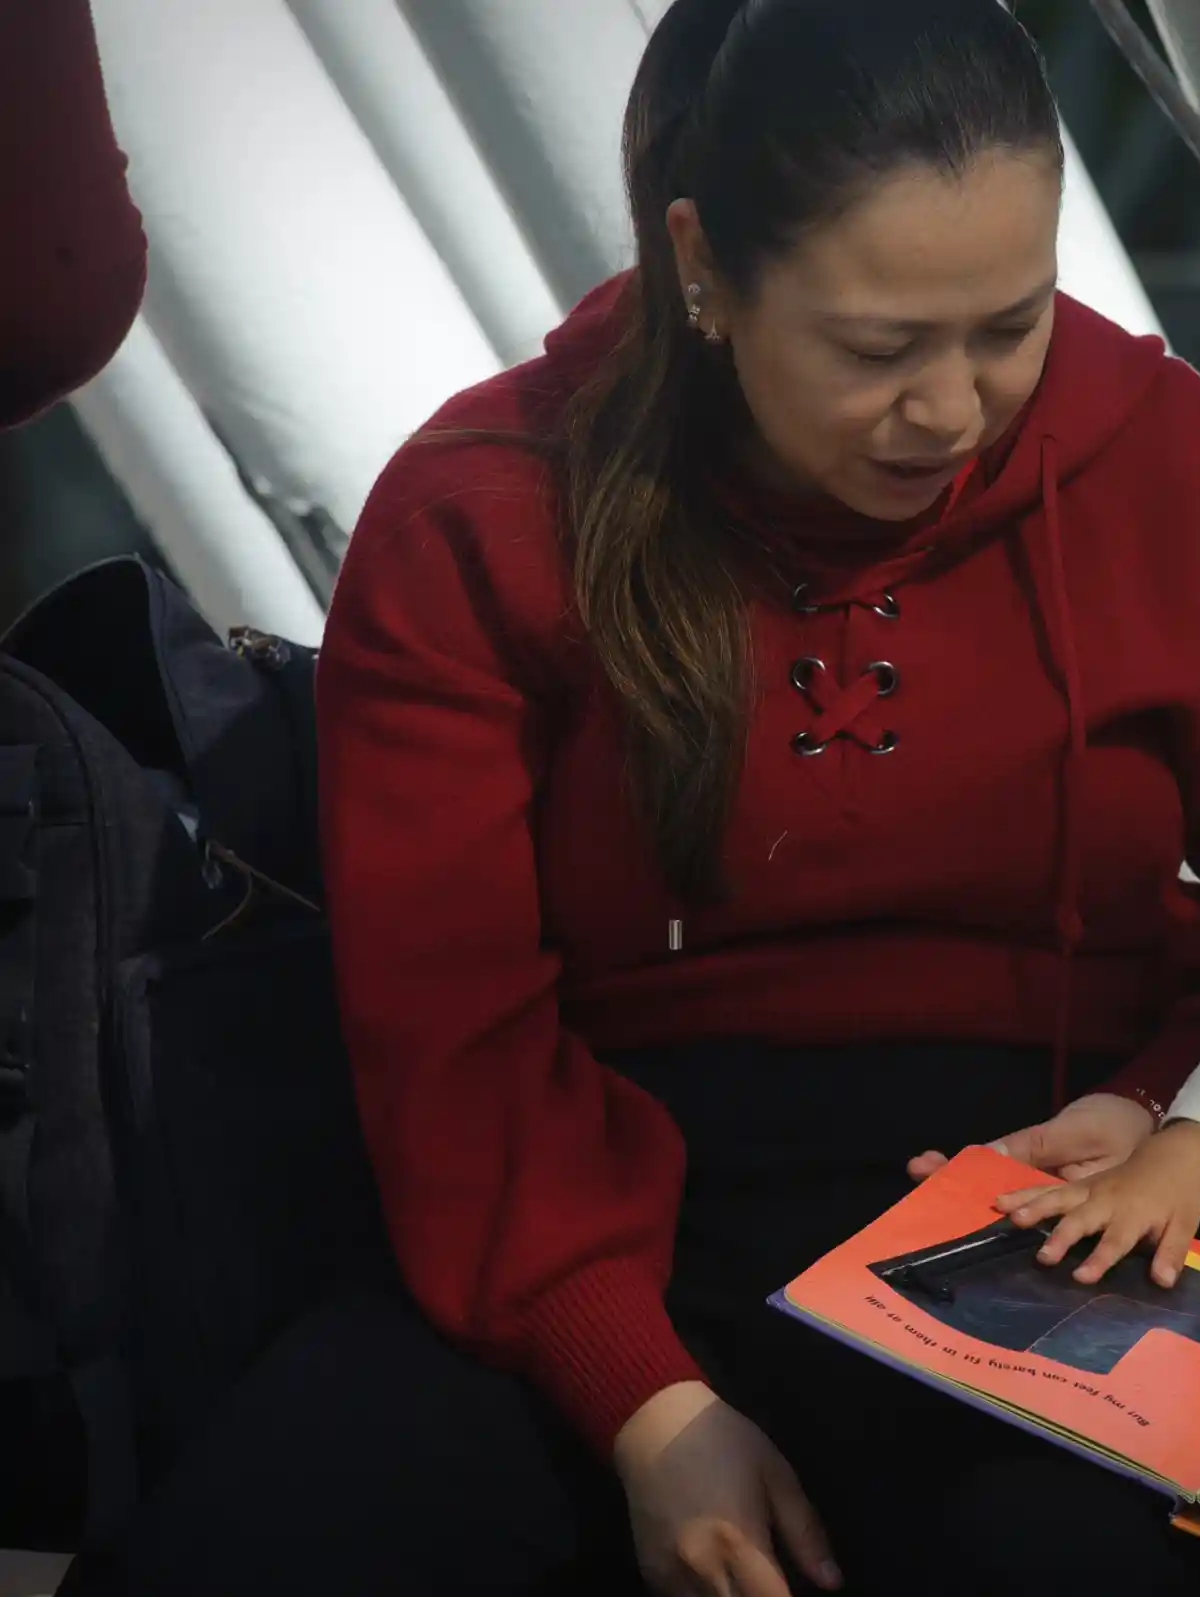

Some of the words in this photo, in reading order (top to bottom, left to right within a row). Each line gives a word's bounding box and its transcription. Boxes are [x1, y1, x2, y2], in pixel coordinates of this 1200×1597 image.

[887, 1313, 902, 1322] at
[905, 1324, 938, 1346] them
[942, 1347, 957, 1356] in
[964, 1354, 981, 1365] fit
[989, 1359, 1036, 1376] barely
[1043, 1371, 1067, 1383] can
[1073, 1382, 1100, 1396] feet
[1104, 1395, 1126, 1410] my
[1127, 1411, 1150, 1426] But
